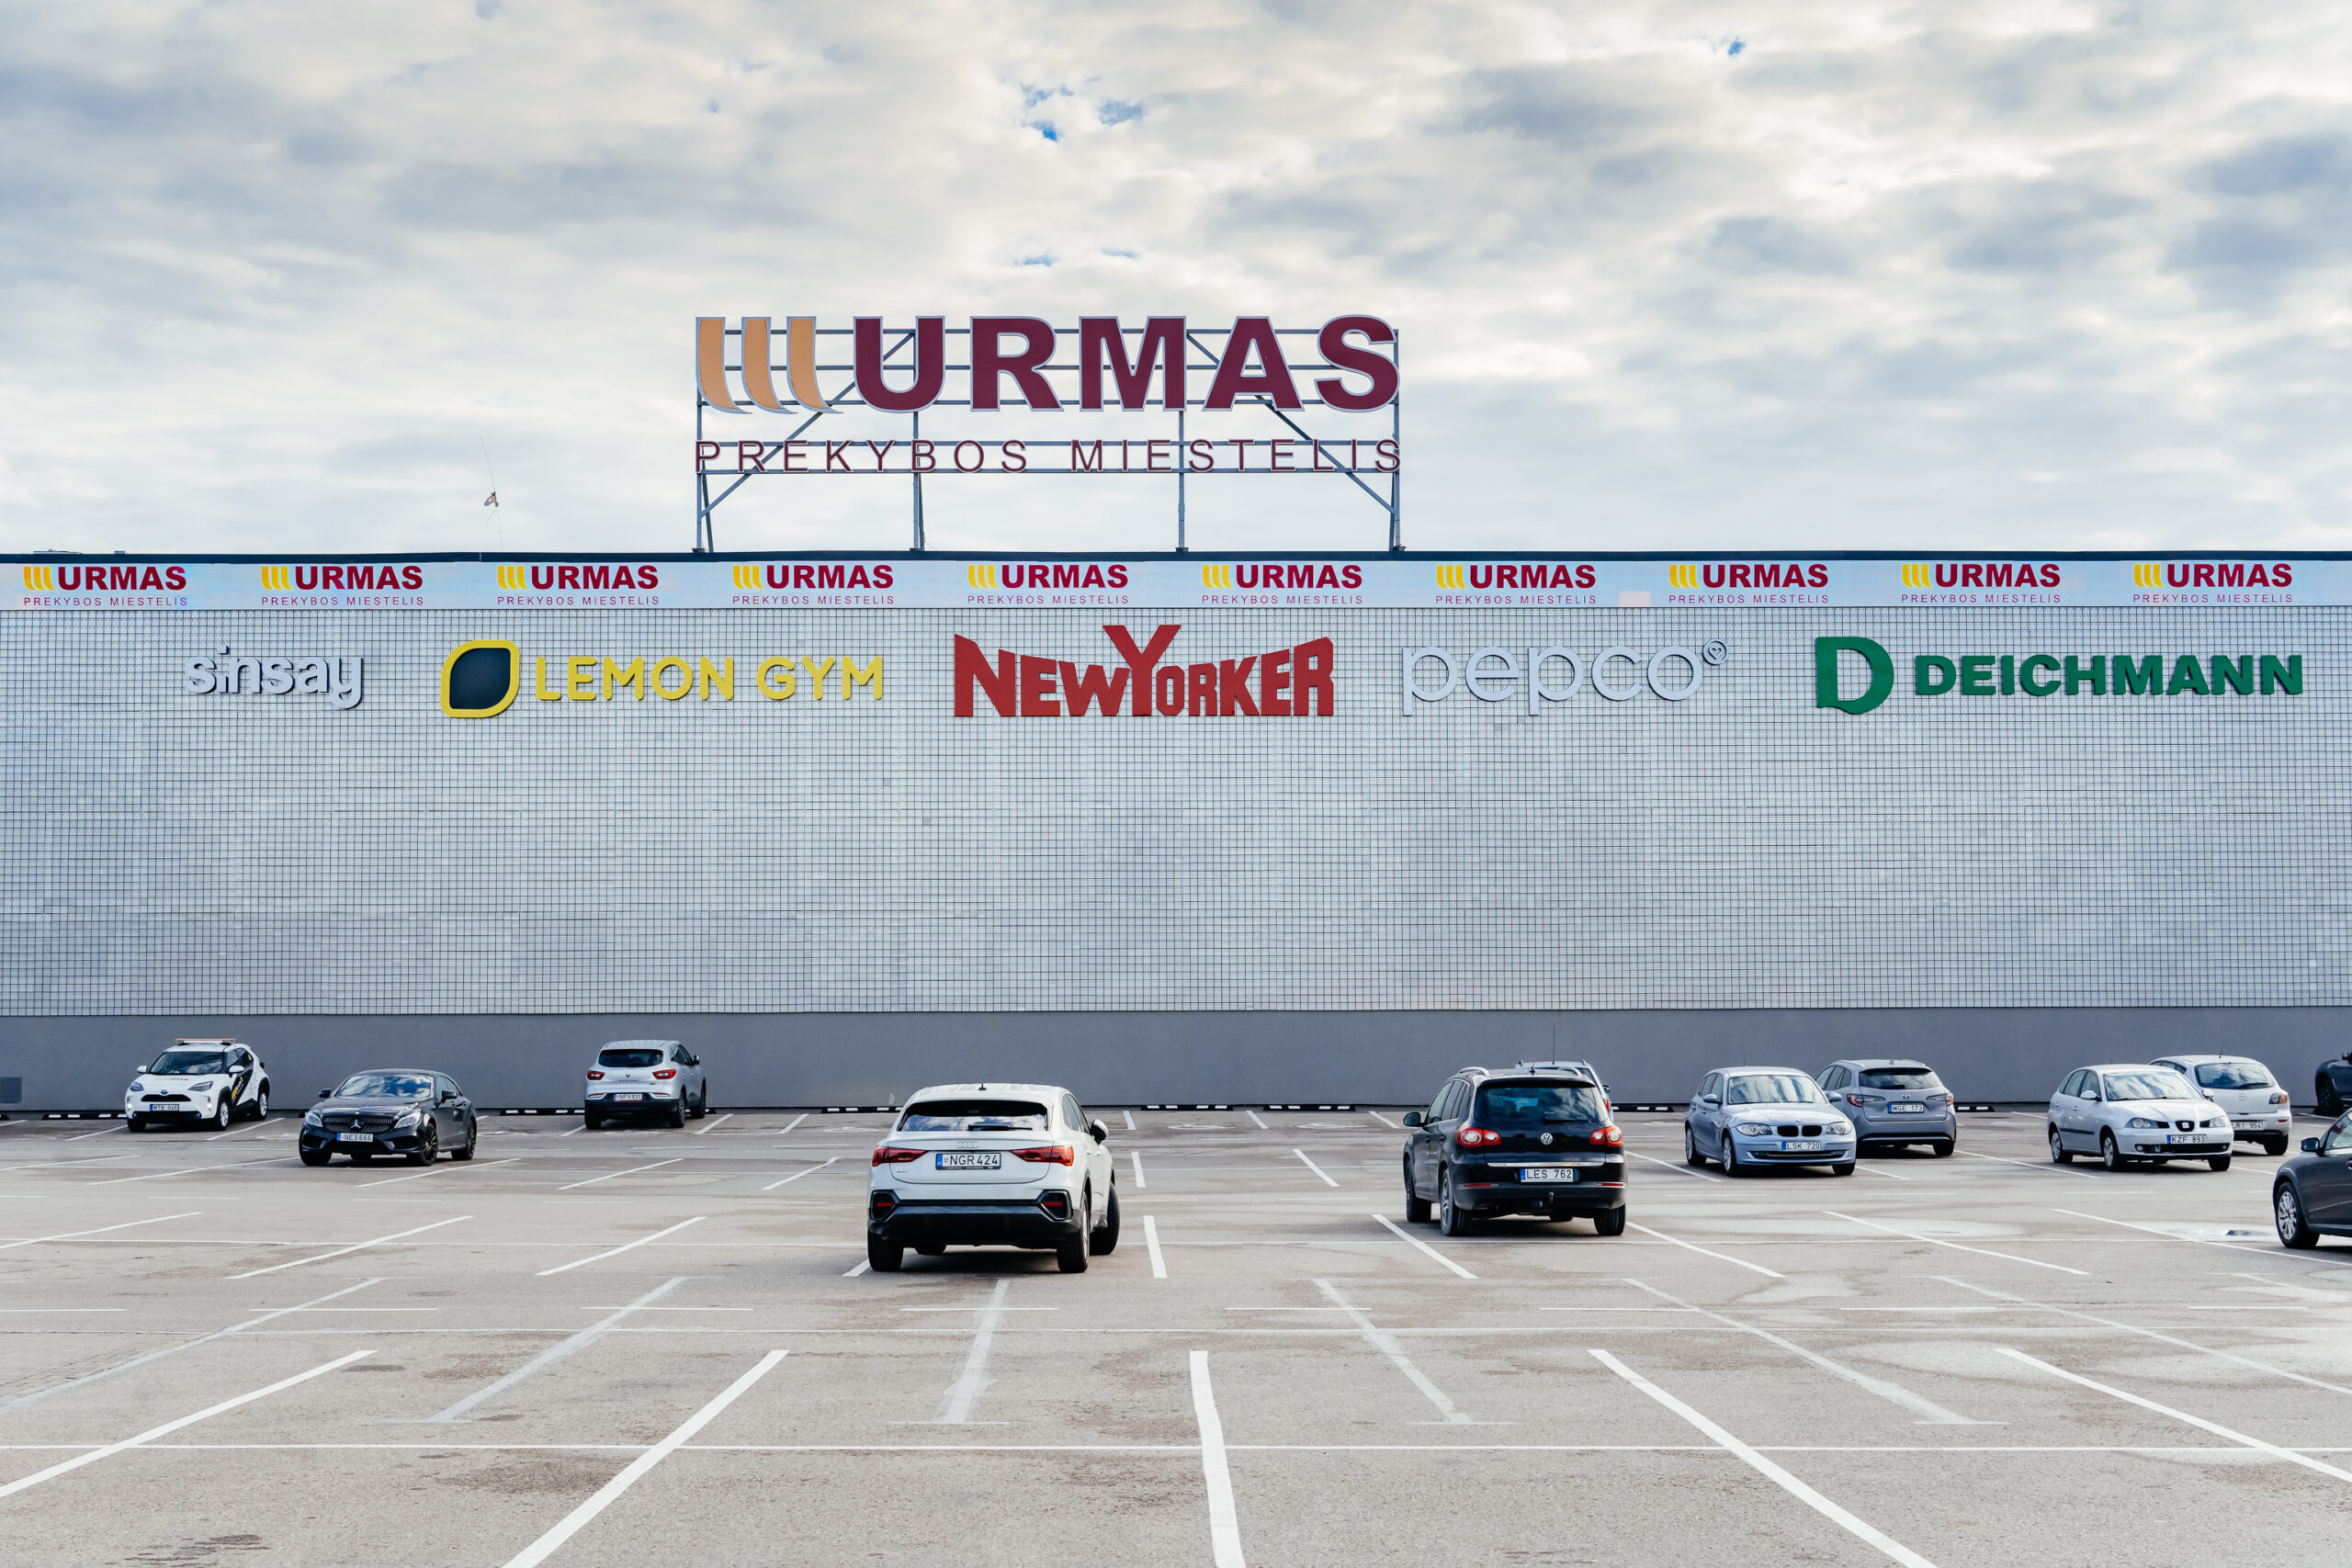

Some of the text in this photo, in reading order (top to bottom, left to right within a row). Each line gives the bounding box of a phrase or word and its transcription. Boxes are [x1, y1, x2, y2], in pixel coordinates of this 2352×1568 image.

[854, 316, 1399, 412] URMAS
[695, 439, 1400, 473] PREKYBOS MIESTELIS
[59, 566, 187, 590] URMAS
[295, 566, 424, 590] URMAS
[531, 565, 659, 590] URMAS
[766, 565, 894, 589] URMAS
[1001, 564, 1128, 589] URMAS
[1236, 564, 1363, 589] URMAS
[1470, 564, 1596, 588] URMAS
[1702, 564, 1828, 588] URMAS
[1935, 563, 2061, 588] URMAS
[2167, 563, 2292, 588] URMAS
[23, 596, 187, 605] PREKYBOS MIESTELIS
[261, 596, 424, 605] PREKYBOS MIESTELIS
[497, 596, 660, 605] PREKYBOS MIESTELIS
[732, 595, 894, 604] PREKYBOS MIESTELIS
[967, 594, 1129, 604] PREKYBOS MIESTELIS
[1202, 594, 1363, 604] PREKYBOS MIESTELIS
[1435, 594, 1596, 604] PREKYBOS MIESTELIS
[1668, 594, 1828, 604] PREKYBOS MIESTELIS
[1901, 593, 2061, 604] PREKYBOS MIESTELIS
[2132, 593, 2292, 604] PREKYBOS MIESTELIS
[185, 644, 364, 710] sinsay
[536, 656, 883, 702] LEMON GYM
[1402, 646, 1702, 717] pepco
[1916, 655, 2303, 696] DEICHMANN
[2171, 1135, 2187, 1144] KZF
[949, 1155, 975, 1166] NGR
[977, 1155, 998, 1166] 424
[1526, 1169, 1572, 1179] LES 762
